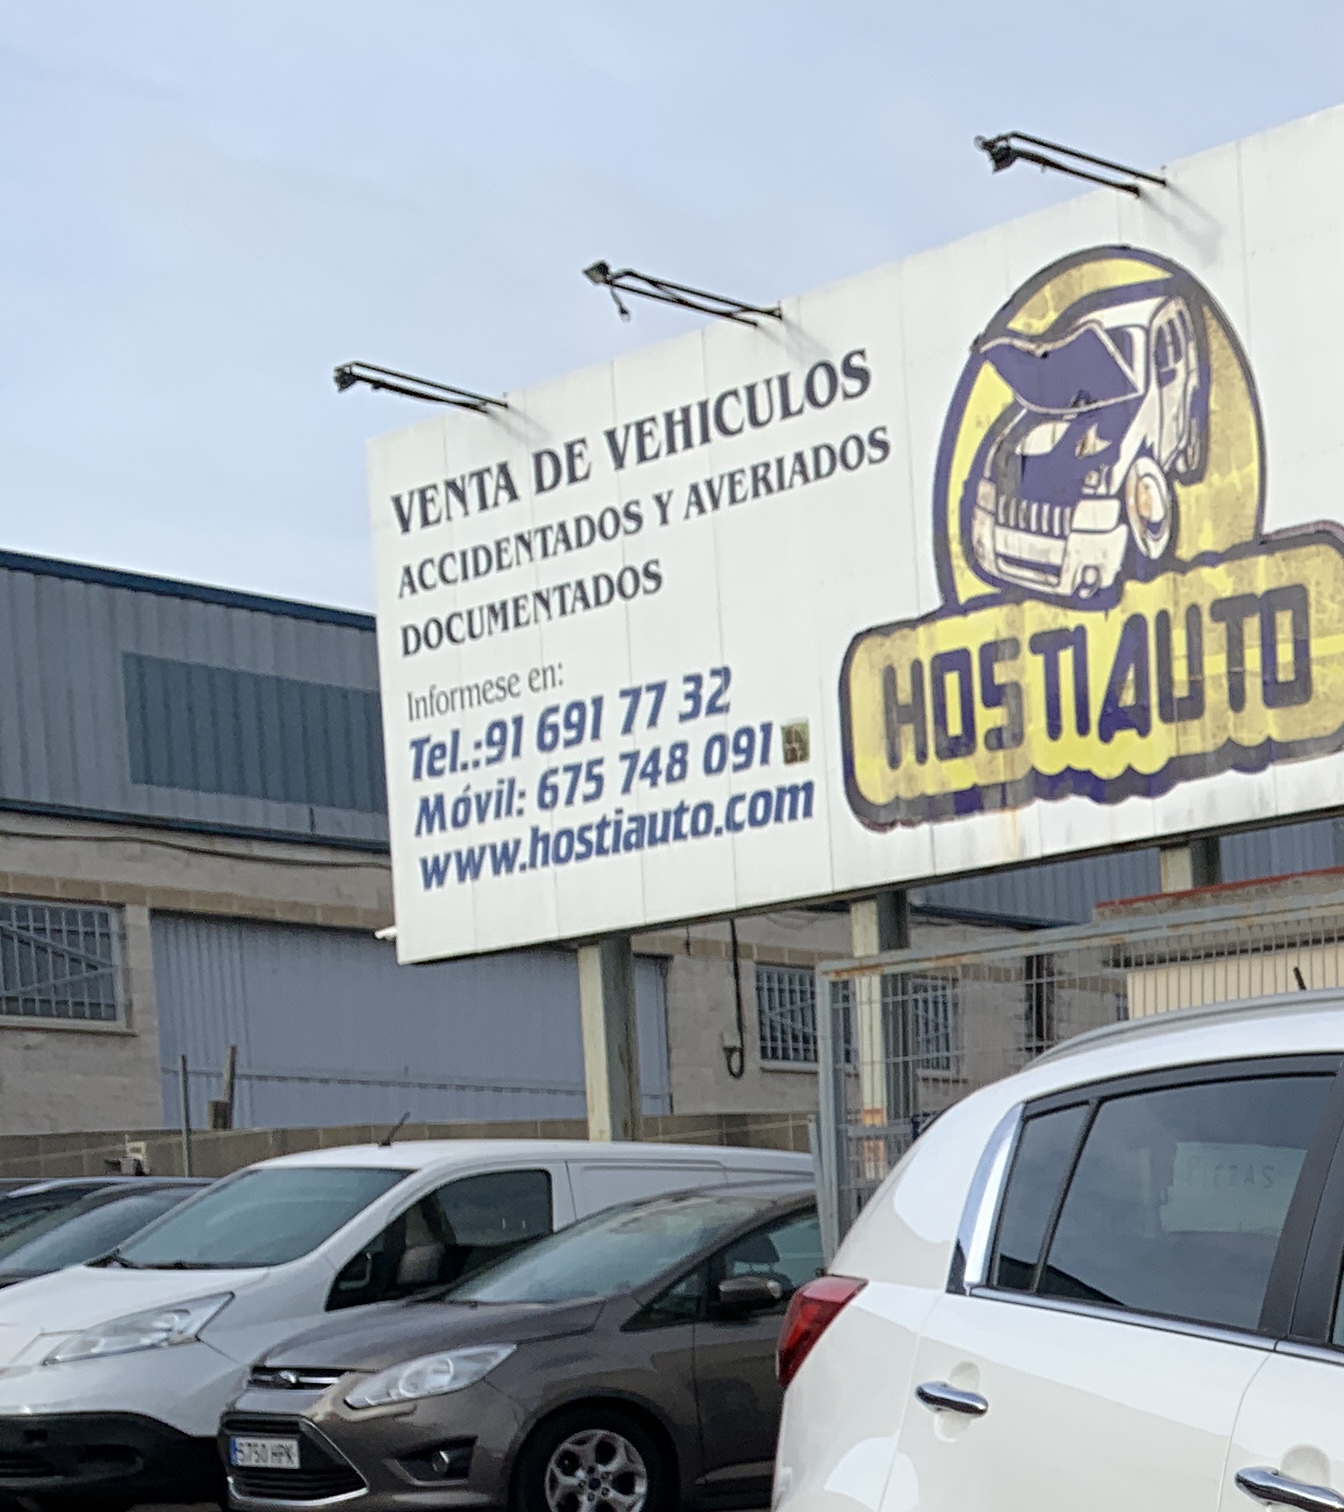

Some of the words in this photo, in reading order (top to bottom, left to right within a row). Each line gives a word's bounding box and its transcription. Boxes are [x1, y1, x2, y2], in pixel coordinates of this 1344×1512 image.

[391, 460, 520, 534] VENTA
[532, 438, 592, 495] DE
[603, 347, 871, 471] VEHICULOS
[398, 500, 643, 599] ACCIDENTADOS
[652, 490, 674, 526] Y
[683, 425, 891, 520] AVERIADOS
[400, 558, 662, 657] DOCUMENTADOS
[407, 673, 520, 722] Informese
[528, 662, 563, 693] en:
[536, 695, 604, 753] 691
[619, 680, 667, 736] 77
[678, 664, 731, 723] 32
[882, 583, 1312, 770] HOSTIAUTO
[415, 777, 525, 837] Móvil:
[537, 757, 604, 811] 675
[619, 741, 689, 796] 748
[703, 721, 773, 777] 091
[420, 779, 815, 890] www.hostiauto.com
